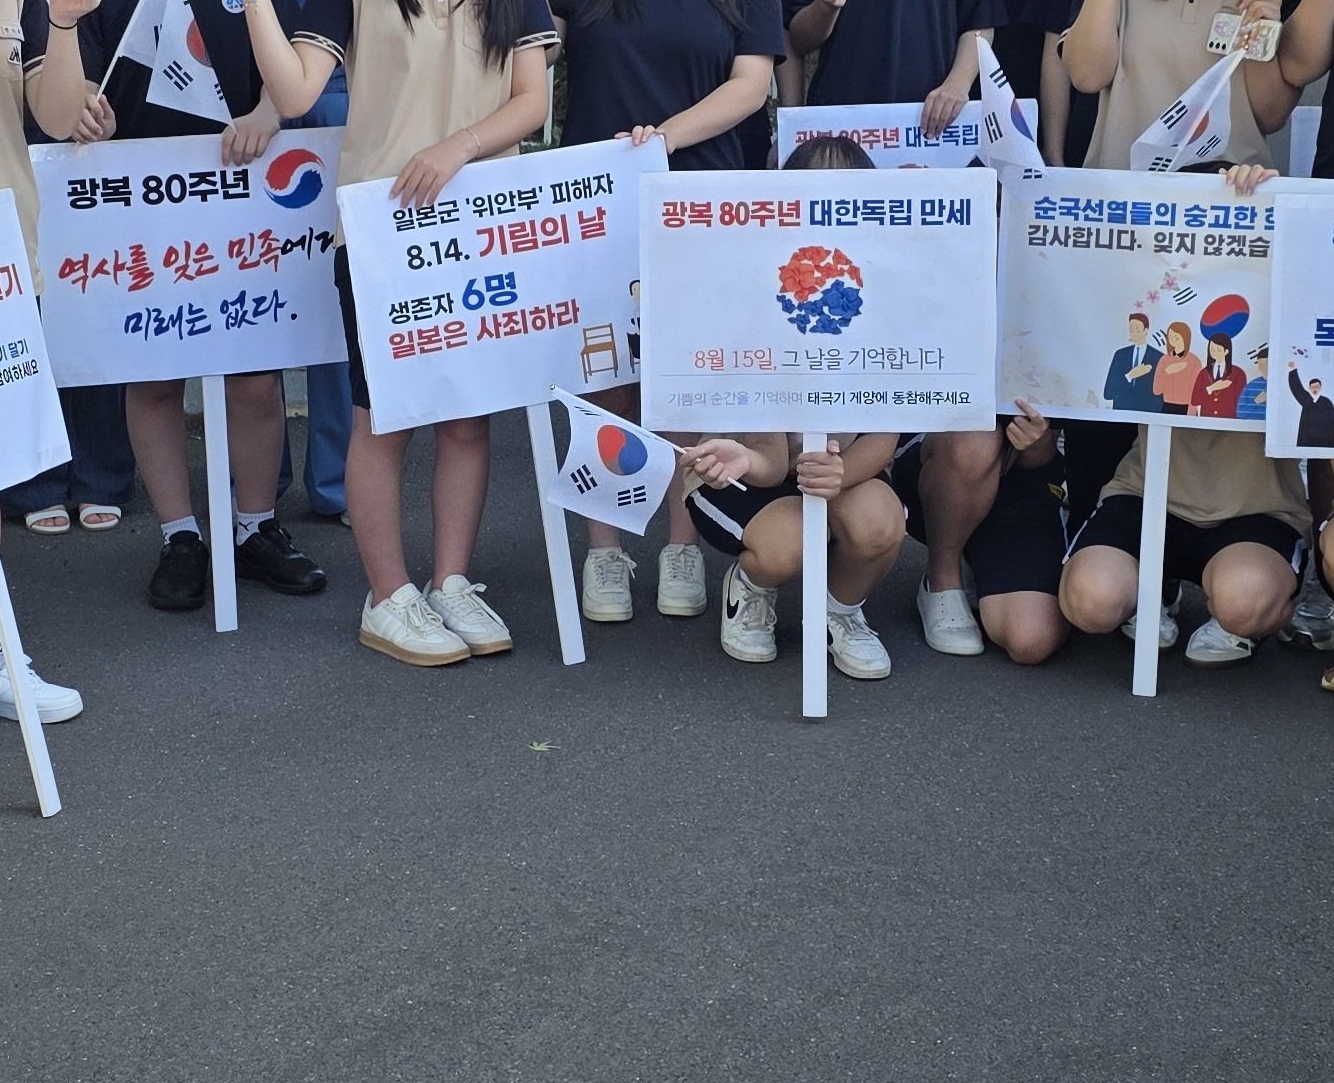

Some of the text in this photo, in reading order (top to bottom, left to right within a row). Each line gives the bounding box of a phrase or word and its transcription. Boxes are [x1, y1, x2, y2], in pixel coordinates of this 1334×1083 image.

[67, 168, 250, 209] 광복 80주년
[392, 173, 614, 232] 일본군 '위안부' 피해자
[662, 198, 971, 228] 광복 80주년 대한독립 만세
[1034, 196, 1177, 227] 순국선열들의
[1184, 204, 1257, 230] 숭고한
[406, 206, 607, 270] 8.14. 기림의 날
[1028, 225, 1142, 251] 감사합니다.
[1153, 232, 1196, 254] 잊지
[58, 243, 155, 294] 역사를
[162, 240, 219, 284] 잊은
[124, 289, 298, 342] 미래는 없다.
[388, 271, 519, 325] 생존자 6명
[388, 299, 580, 360] 일본은 사죄하라
[8, 338, 29, 363] 달기
[694, 347, 725, 371] 8월
[781, 349, 801, 368] 그
[805, 347, 844, 371] 날을
[848, 347, 945, 371] 기억합니다
[667, 390, 971, 406] 기쁨의 순간을 기억하며 태극기 게양에 동참해주세요
